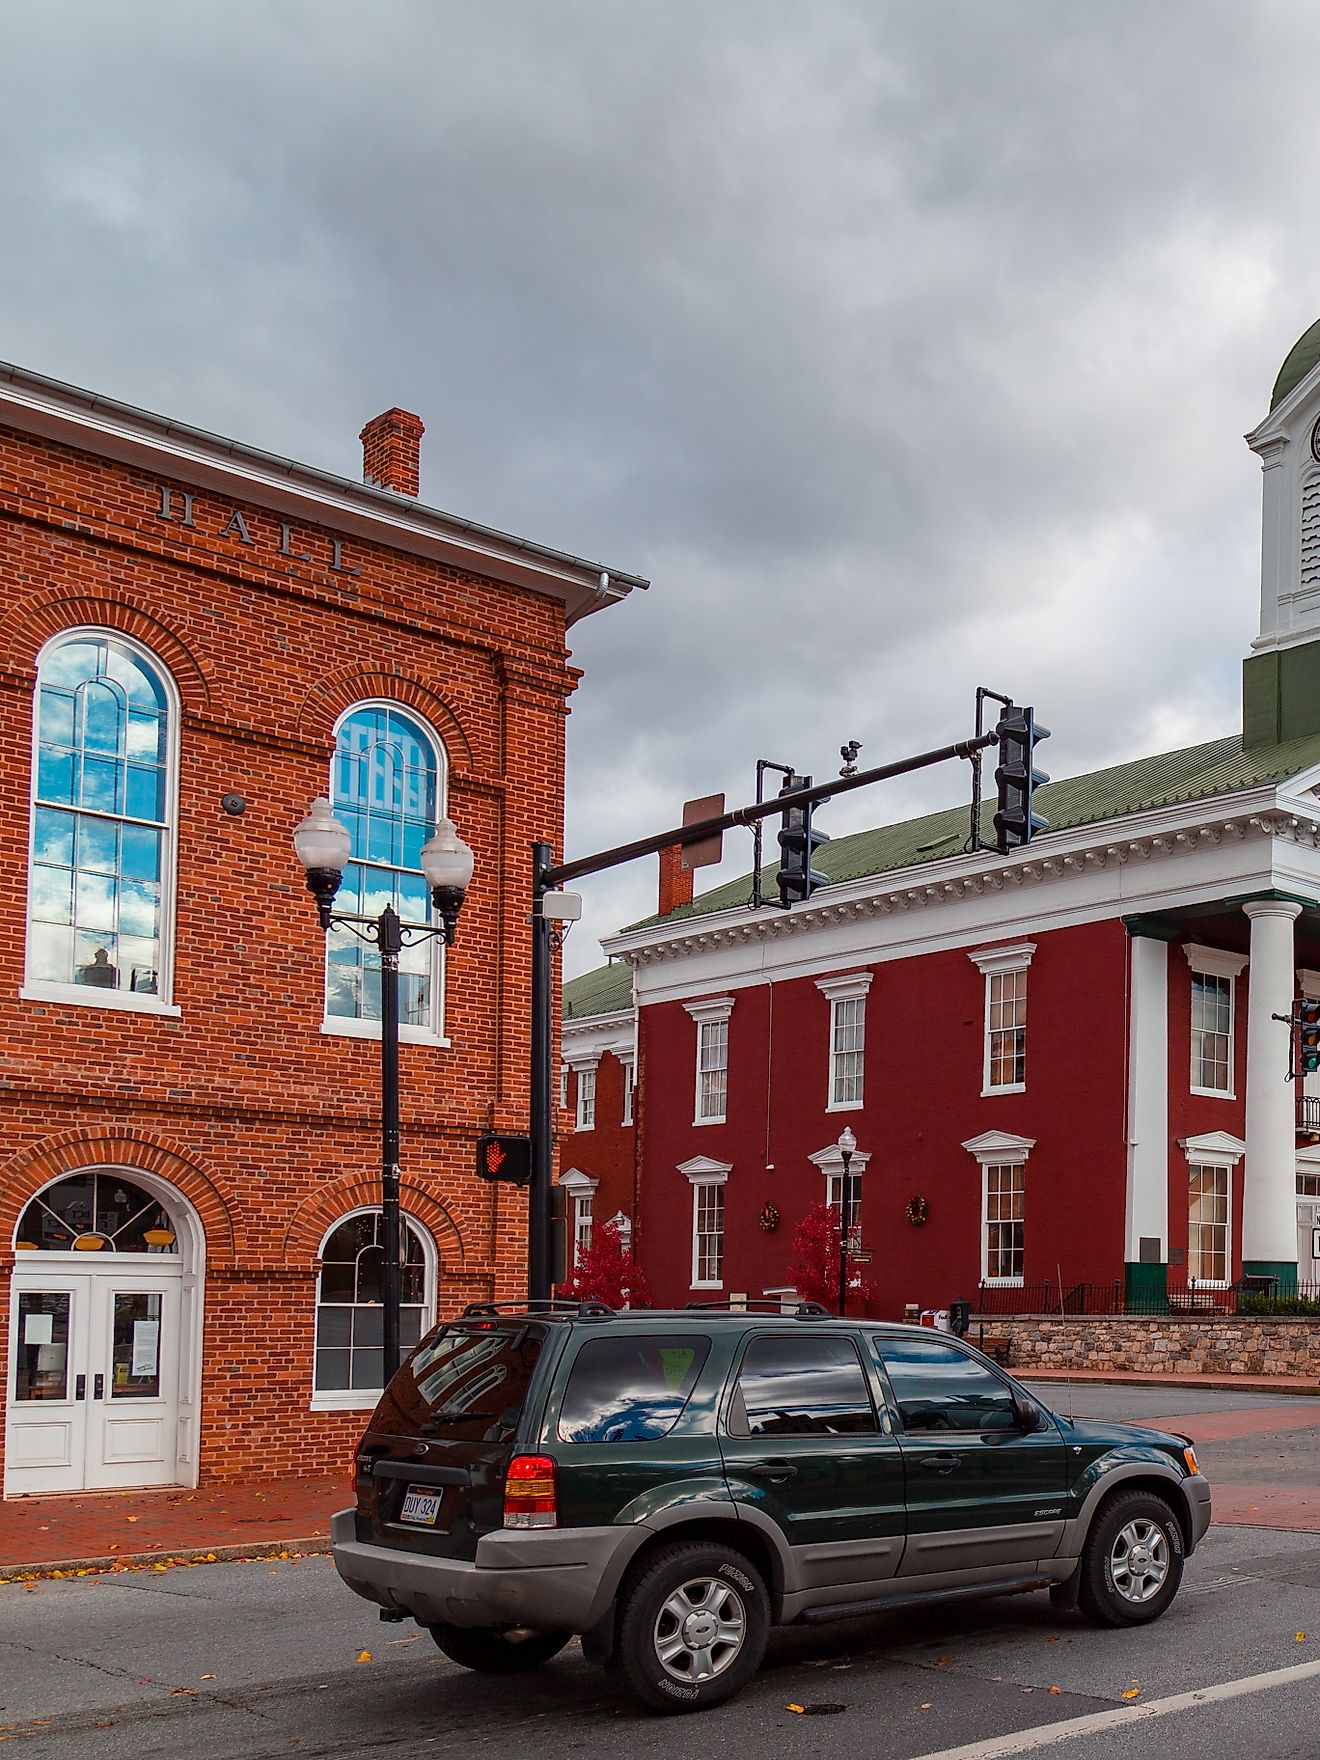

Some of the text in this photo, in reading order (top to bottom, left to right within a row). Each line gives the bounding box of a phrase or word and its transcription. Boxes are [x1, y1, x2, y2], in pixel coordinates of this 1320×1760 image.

[156, 485, 361, 577] HALL
[403, 1496, 438, 1516] DUY 324
[1034, 1508, 1062, 1517] ESCAPE
[717, 1562, 756, 1592] FUZION
[656, 1678, 700, 1700] FUZION
